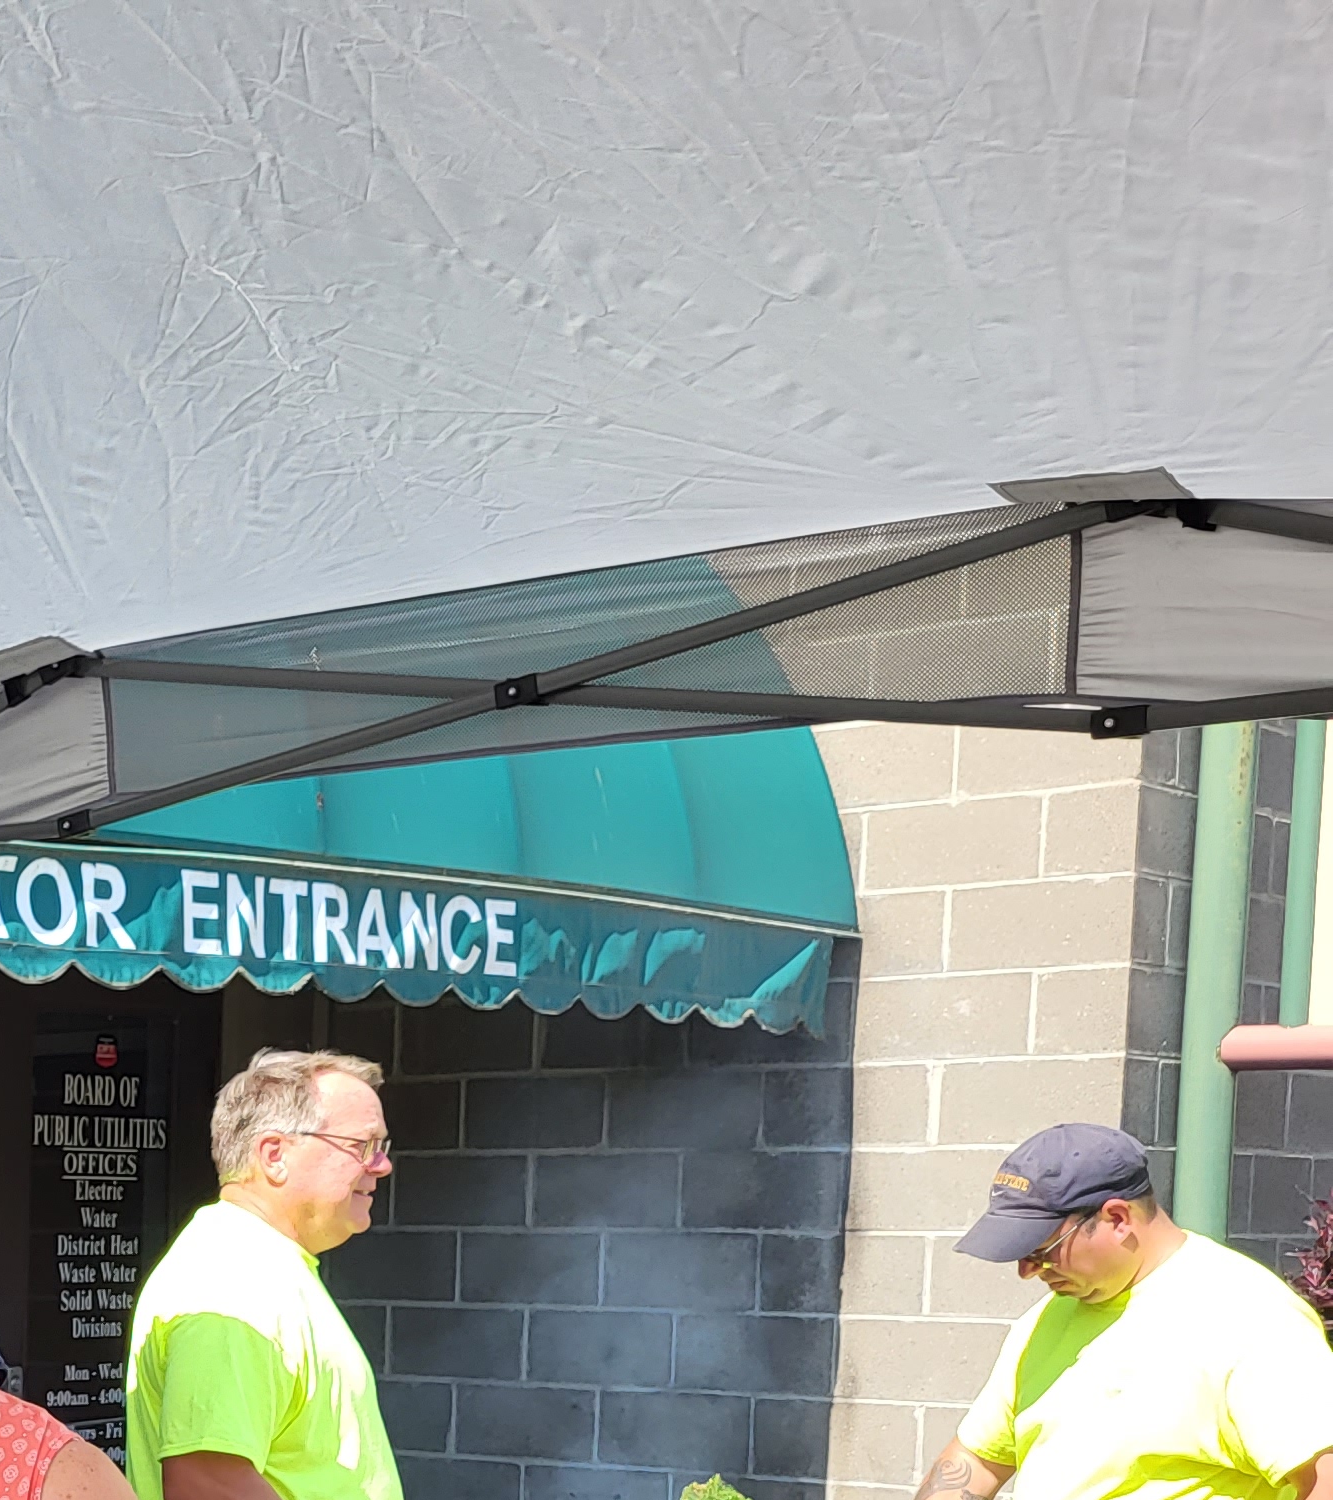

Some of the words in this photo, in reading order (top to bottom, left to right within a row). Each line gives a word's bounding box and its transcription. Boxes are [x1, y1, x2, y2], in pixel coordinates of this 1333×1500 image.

[181, 869, 517, 977] ENTRANCE
[64, 1074, 115, 1106] BOARD
[119, 1076, 140, 1107] OF
[33, 1114, 89, 1146] PUBLIC
[94, 1116, 167, 1149] UTILITIES
[64, 1153, 137, 1175] OFFICES
[75, 1180, 124, 1201] Electric
[81, 1207, 118, 1228] Water
[57, 1234, 105, 1256] District
[110, 1234, 138, 1255] Heat
[58, 1262, 96, 1283] Waste
[100, 1262, 137, 1283] Water
[60, 1289, 92, 1311] Solid
[97, 1289, 133, 1310] Waste
[72, 1317, 122, 1338] Divisions
[64, 1365, 90, 1381] Mon
[98, 1363, 123, 1379] Wed
[47, 1390, 89, 1407] 9:00am
[98, 1388, 126, 1407] 4:00p
[106, 1423, 123, 1438] Fri
